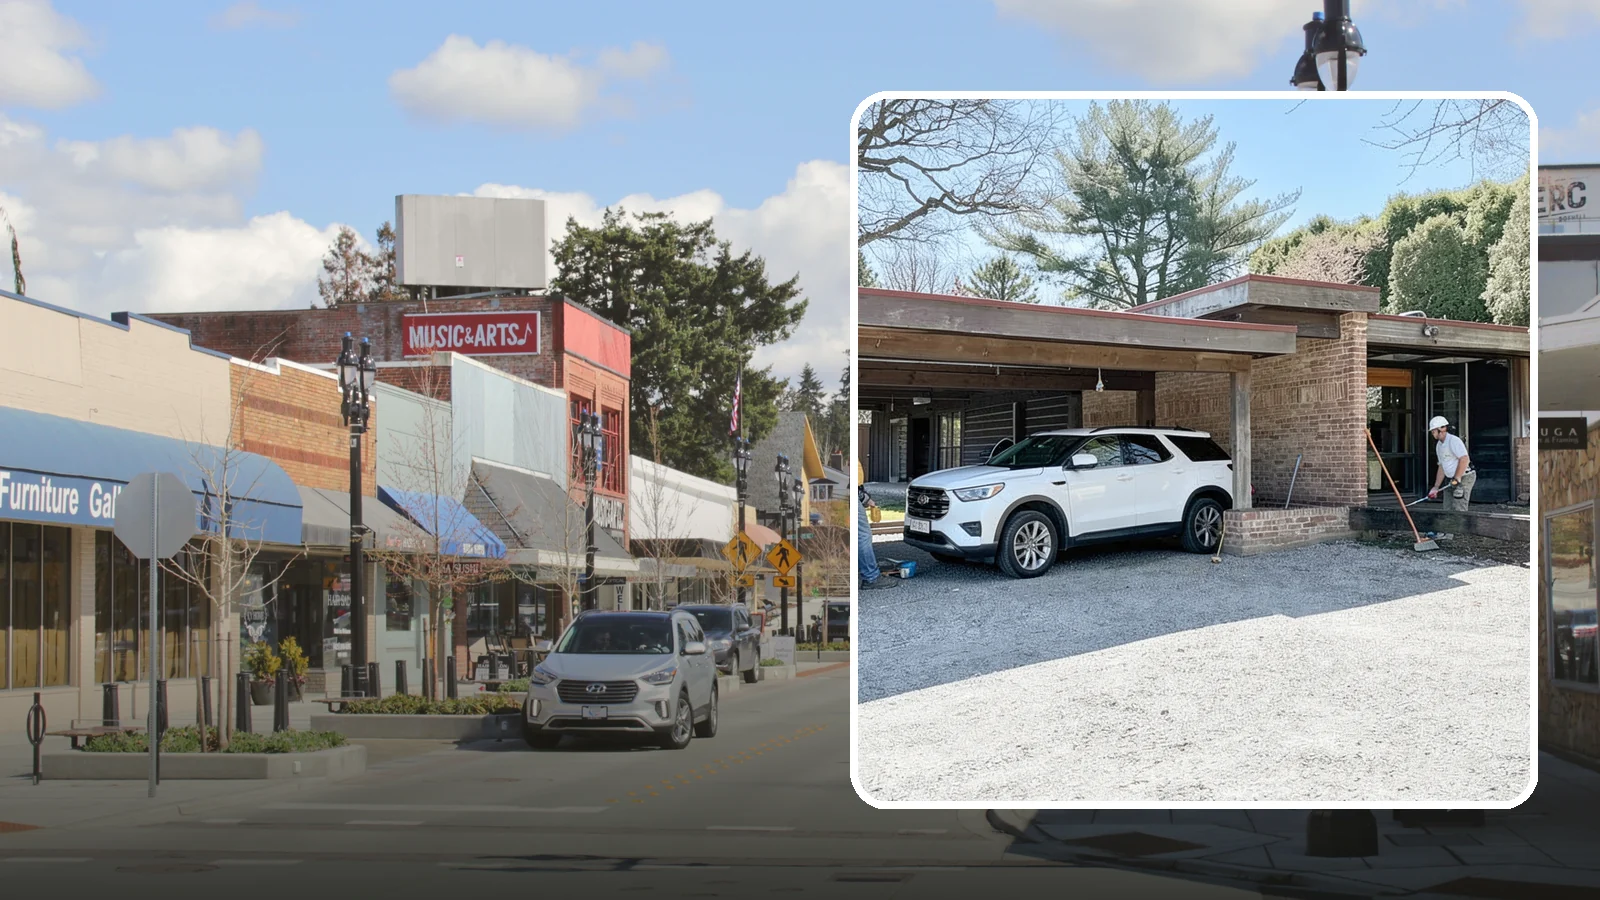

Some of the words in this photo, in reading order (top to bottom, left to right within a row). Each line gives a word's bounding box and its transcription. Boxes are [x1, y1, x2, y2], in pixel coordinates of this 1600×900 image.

[409, 323, 520, 348] MUSIC&ARTS
[1540, 427, 1577, 436] UGA
[0, 471, 79, 515] Furniture
[89, 482, 121, 519] Gal
